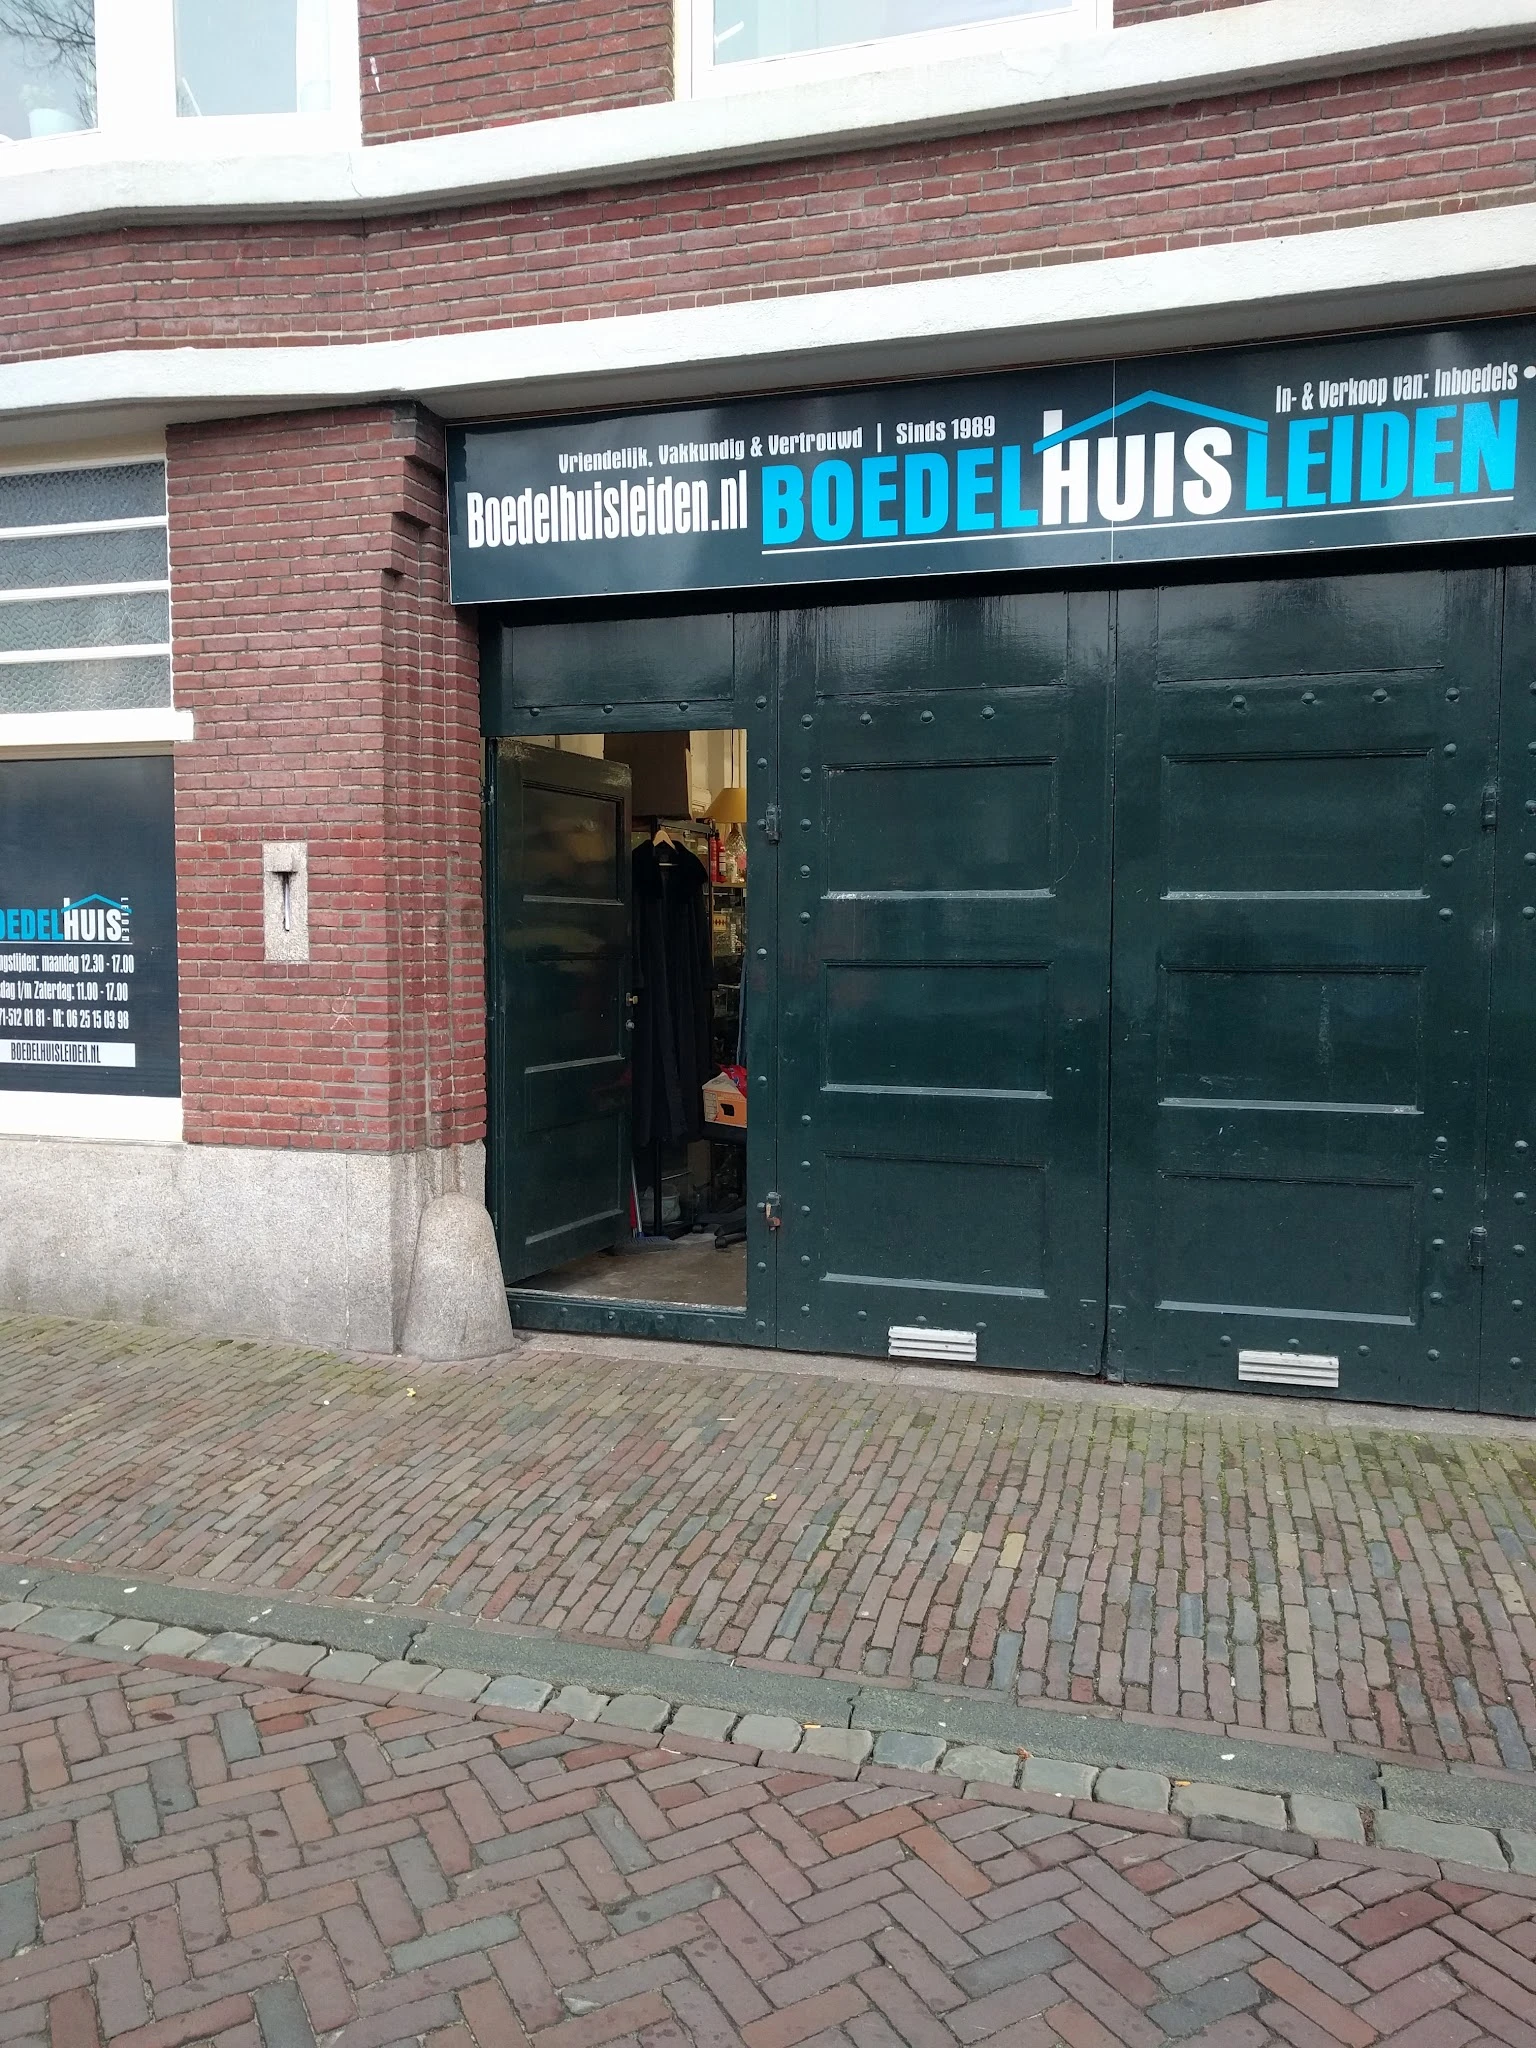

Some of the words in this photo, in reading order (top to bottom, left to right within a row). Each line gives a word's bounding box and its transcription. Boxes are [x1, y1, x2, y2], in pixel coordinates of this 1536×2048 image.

[1276, 385, 1297, 413] In-
[1302, 382, 1313, 411] &
[1319, 377, 1387, 409] Verkoop
[1393, 373, 1429, 402] van:
[1434, 362, 1518, 398] Inboedels
[559, 446, 653, 474] Vriendelijk,
[658, 436, 745, 464] Vakkundig
[750, 436, 763, 457] &
[768, 427, 863, 455] Vertrouwd
[896, 420, 947, 445] Sinds
[951, 415, 996, 440] 1989
[466, 470, 748, 549] Boedelhuisleiden.nl
[42, 953, 79, 974] maandag
[81, 954, 104, 973] 12.30
[112, 954, 135, 974] 17.00
[0, 980, 16, 1001] dag
[17, 980, 32, 1001] t/m
[34, 981, 75, 1002] Zaterdag:
[76, 982, 98, 1001] 11.00
[106, 982, 129, 1001] 17.00
[24, 1008, 34, 1027] 01
[36, 1008, 45, 1027] 81
[66, 1009, 78, 1028] 06
[80, 1009, 91, 1028] 25
[92, 1010, 102, 1029] 15
[104, 1010, 115, 1029] 03
[117, 1010, 129, 1029] 98
[10, 1042, 101, 1063] BOEDELHUISLEIDEN.NL
